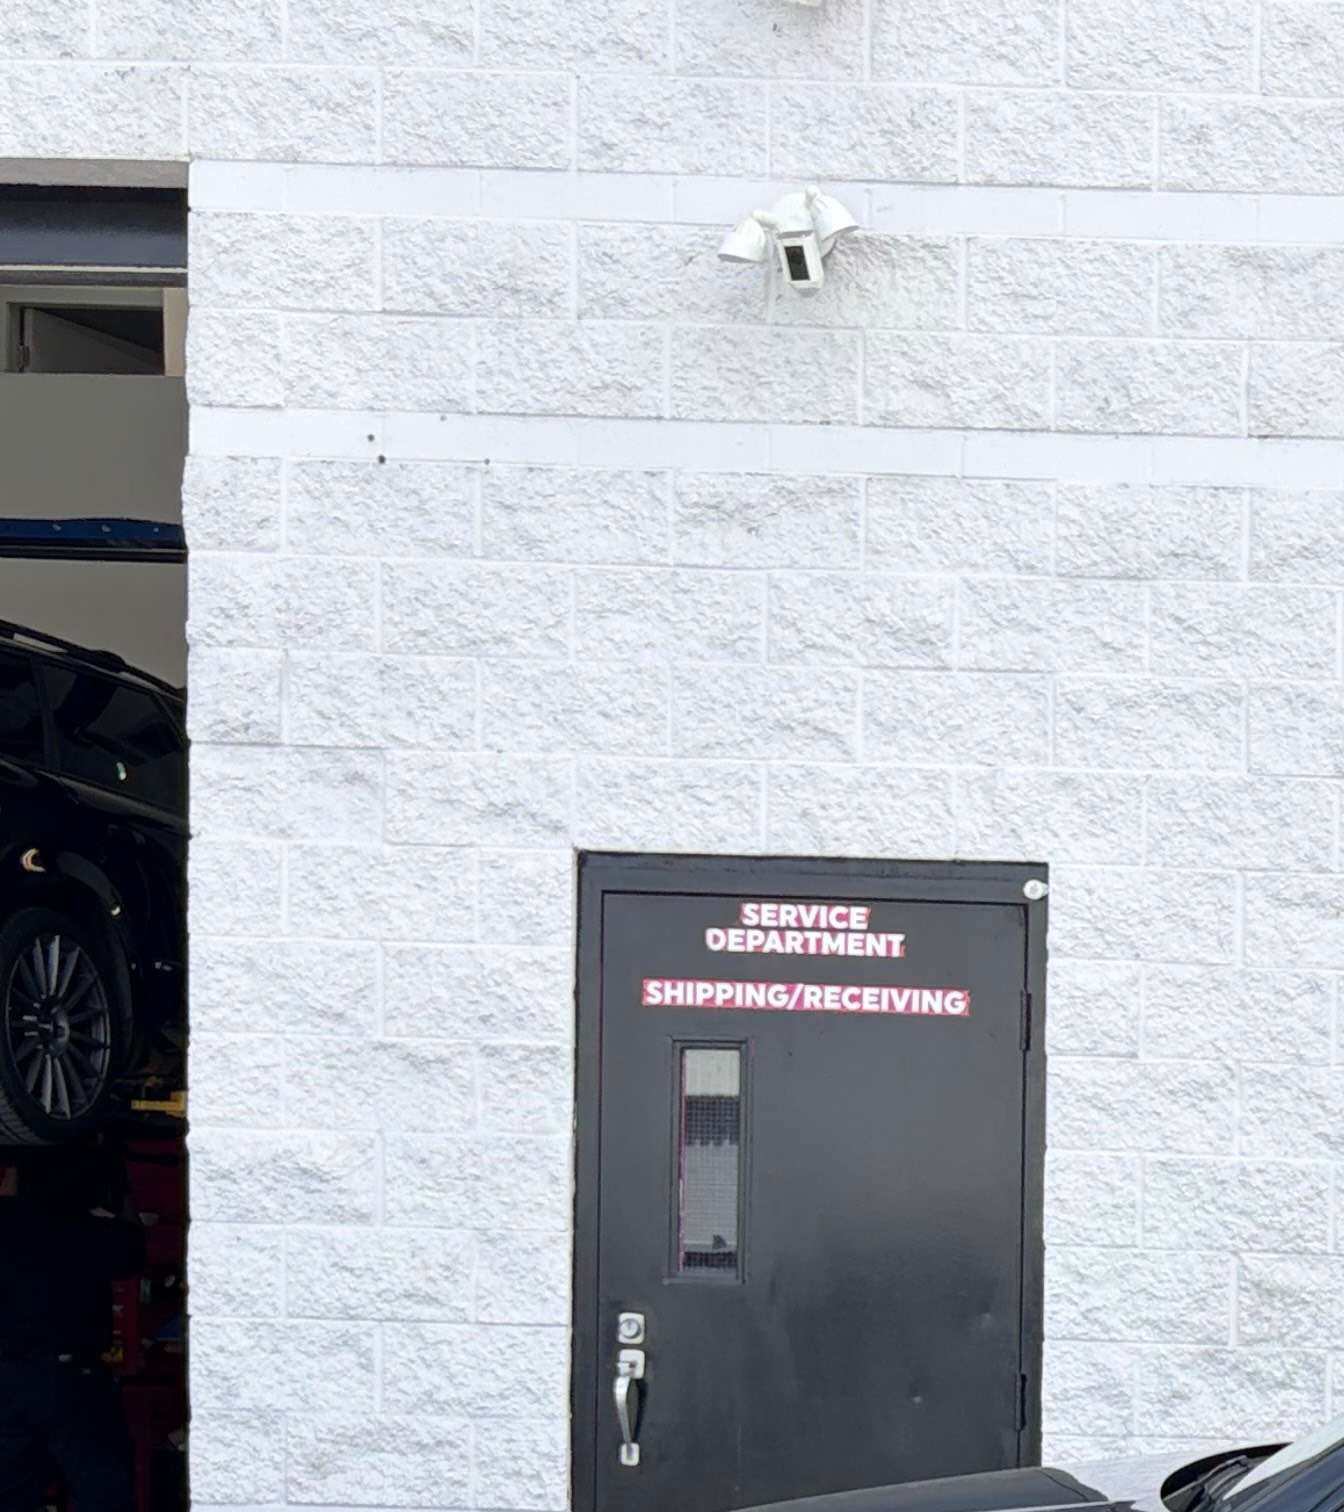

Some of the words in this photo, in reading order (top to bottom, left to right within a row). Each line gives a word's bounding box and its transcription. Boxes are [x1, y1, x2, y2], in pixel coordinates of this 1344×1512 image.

[741, 903, 870, 930] SERVICE
[704, 928, 905, 958] DEPARTMENT
[644, 979, 970, 1015] SHIPPING/RECEIVING
